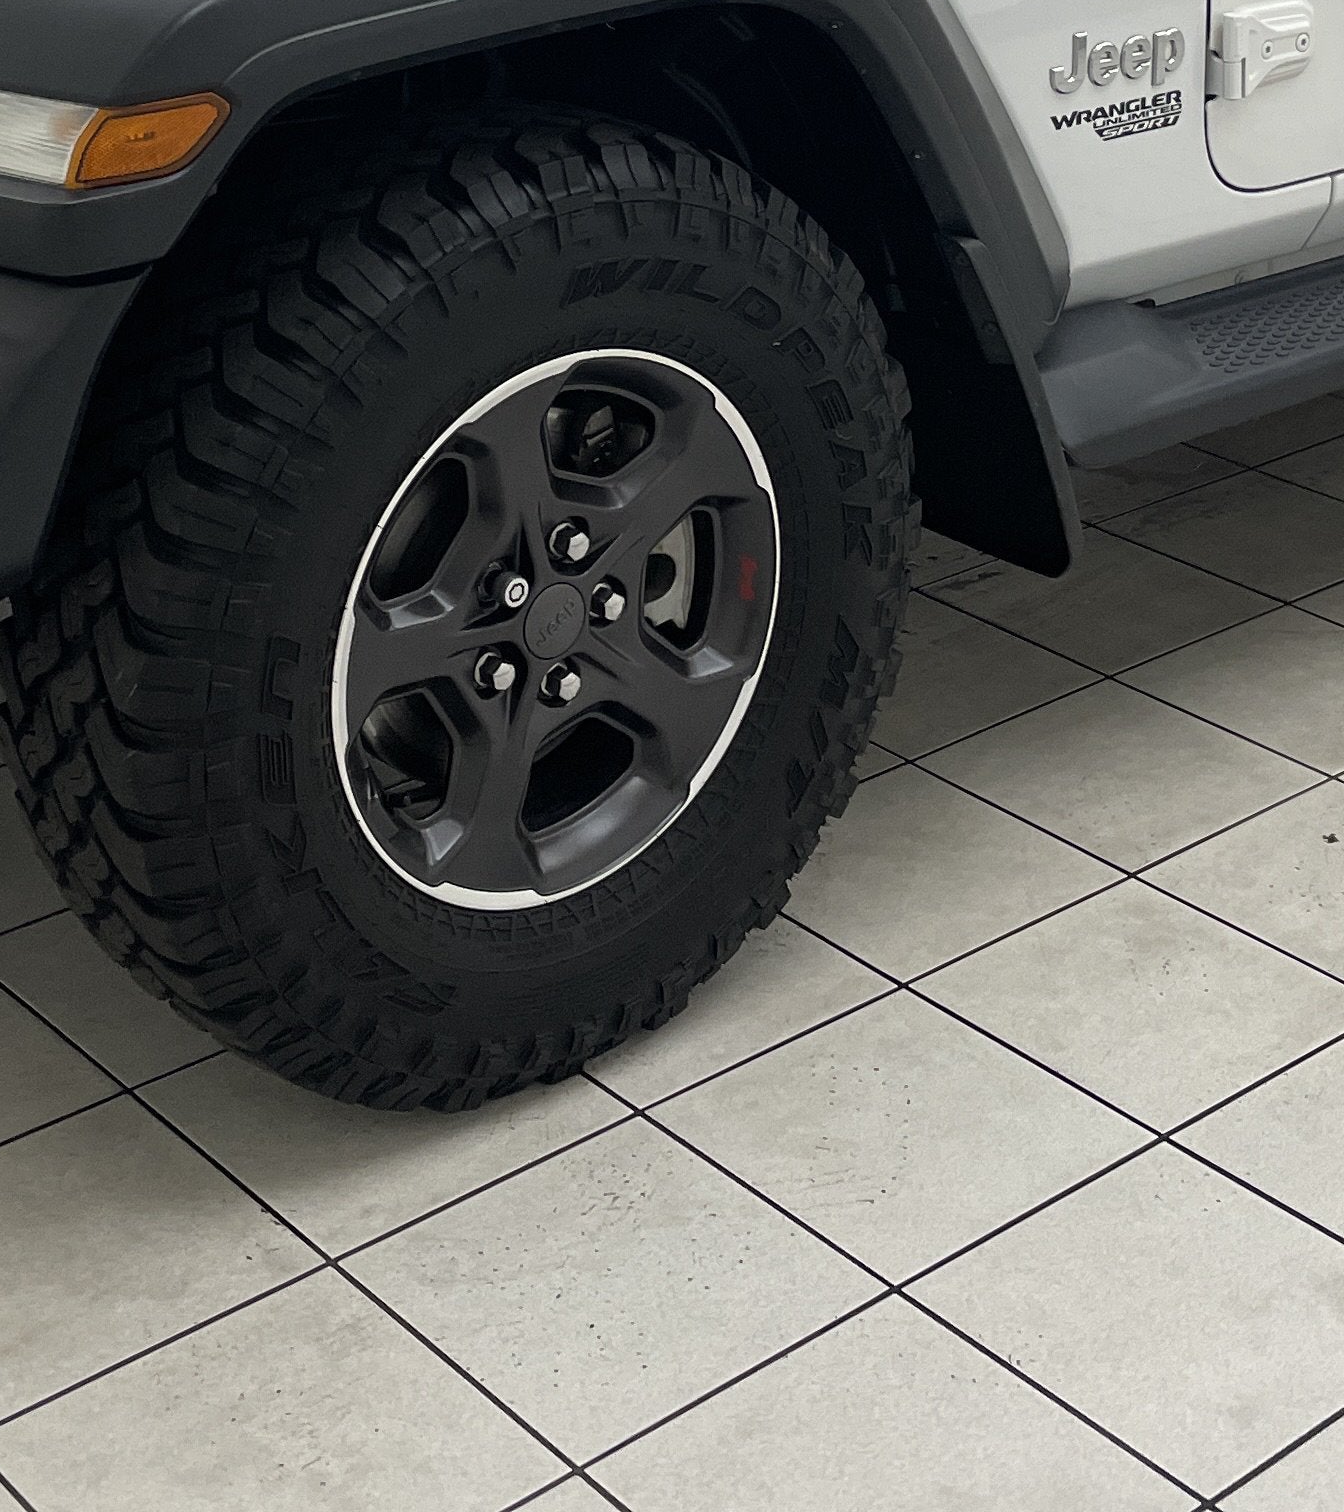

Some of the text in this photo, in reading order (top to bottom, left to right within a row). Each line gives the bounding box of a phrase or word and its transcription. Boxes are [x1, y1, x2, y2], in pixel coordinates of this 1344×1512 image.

[1049, 26, 1186, 95] Jeep
[1050, 90, 1182, 130] WRANGLER
[1092, 103, 1183, 129] UNLIMITED
[1101, 115, 1177, 139] SPORT
[535, 597, 576, 648] Jeep
